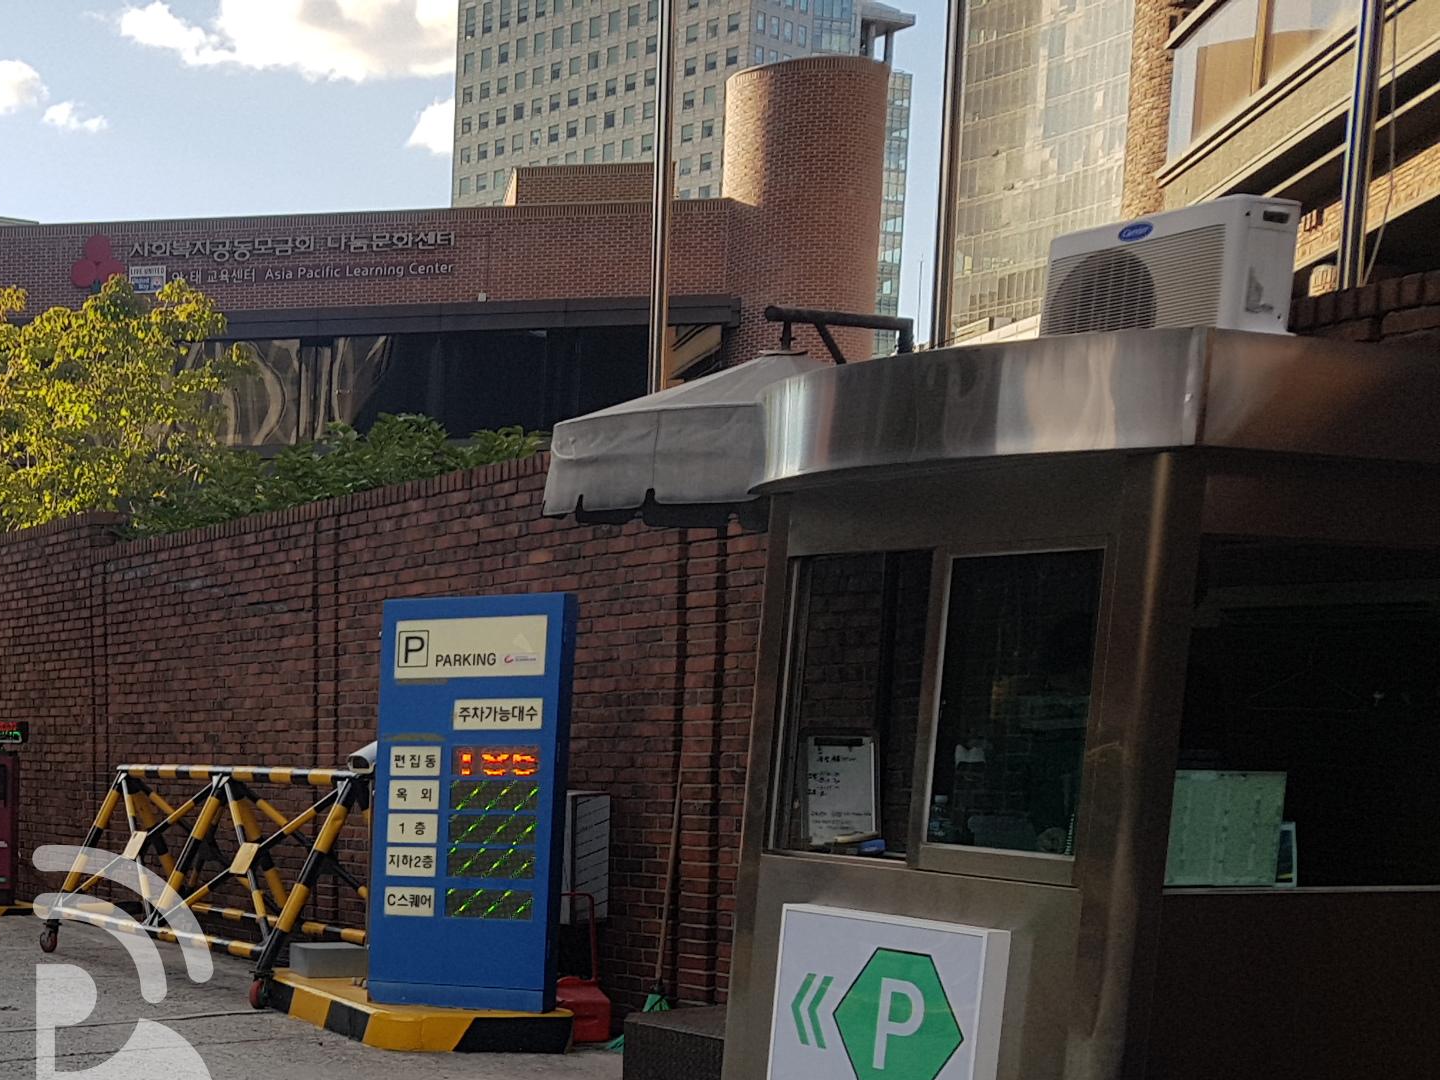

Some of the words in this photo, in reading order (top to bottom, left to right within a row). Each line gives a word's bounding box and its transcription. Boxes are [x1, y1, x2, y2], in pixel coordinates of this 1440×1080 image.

[129, 235, 315, 262] 사회복지공동모금회
[327, 231, 456, 253] 나눔문화센터
[207, 267, 256, 283] 교육센터
[264, 267, 293, 280] Asia
[297, 265, 341, 279] Pacific
[346, 263, 404, 278] Learning
[410, 262, 453, 275] Center
[404, 635, 425, 664] P
[435, 652, 497, 668] PARKING
[458, 704, 538, 723] 주차가능대수
[389, 854, 434, 869] 지하2층
[387, 893, 432, 909] C스퀘어
[872, 976, 925, 1071] P
